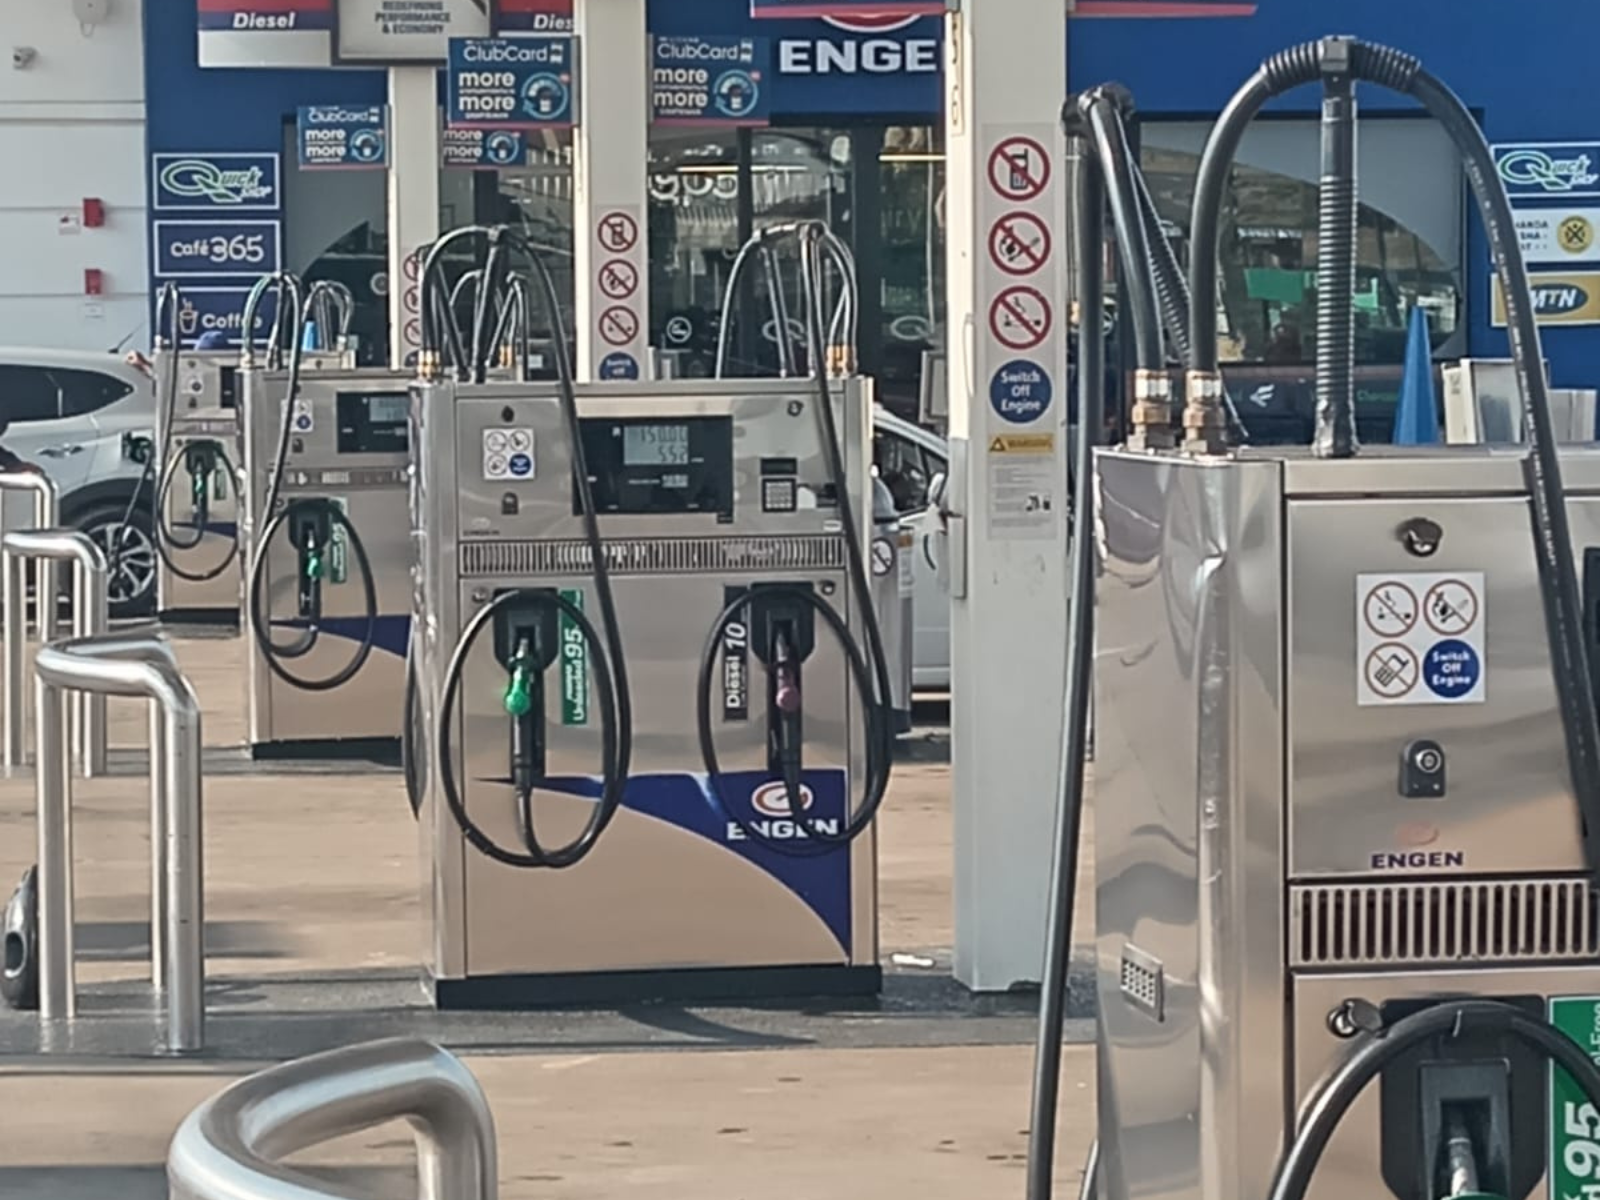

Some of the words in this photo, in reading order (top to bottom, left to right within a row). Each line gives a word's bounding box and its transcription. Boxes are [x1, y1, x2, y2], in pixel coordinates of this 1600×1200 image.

[233, 12, 295, 29] Diesel
[375, 13, 450, 22] PERFORMANCE
[533, 14, 573, 30] Dies
[392, 24, 444, 34] ECONOMY
[463, 46, 548, 61] ClubCard
[657, 43, 739, 60] ClubCard
[779, 40, 945, 73] ENGE
[458, 72, 515, 87] more
[654, 68, 708, 84] more
[458, 96, 515, 111] more
[654, 92, 708, 107] more
[305, 130, 346, 141] more
[443, 130, 483, 141] more
[306, 146, 346, 157] more
[443, 147, 483, 158] more
[170, 239, 209, 257] Café
[209, 234, 265, 263] 365
[1531, 288, 1577, 309] MTN
[202, 312, 262, 329] Coffe
[1001, 371, 1041, 384] Switch
[1011, 385, 1031, 397] Off
[1001, 399, 1041, 414] Engine
[564, 627, 583, 659] 95
[725, 622, 747, 650] 10
[1432, 650, 1470, 662] Switch
[1441, 662, 1462, 674] Off
[726, 656, 741, 709] Diesel
[1432, 674, 1471, 688] Engine
[1371, 850, 1464, 869] ENGEN
